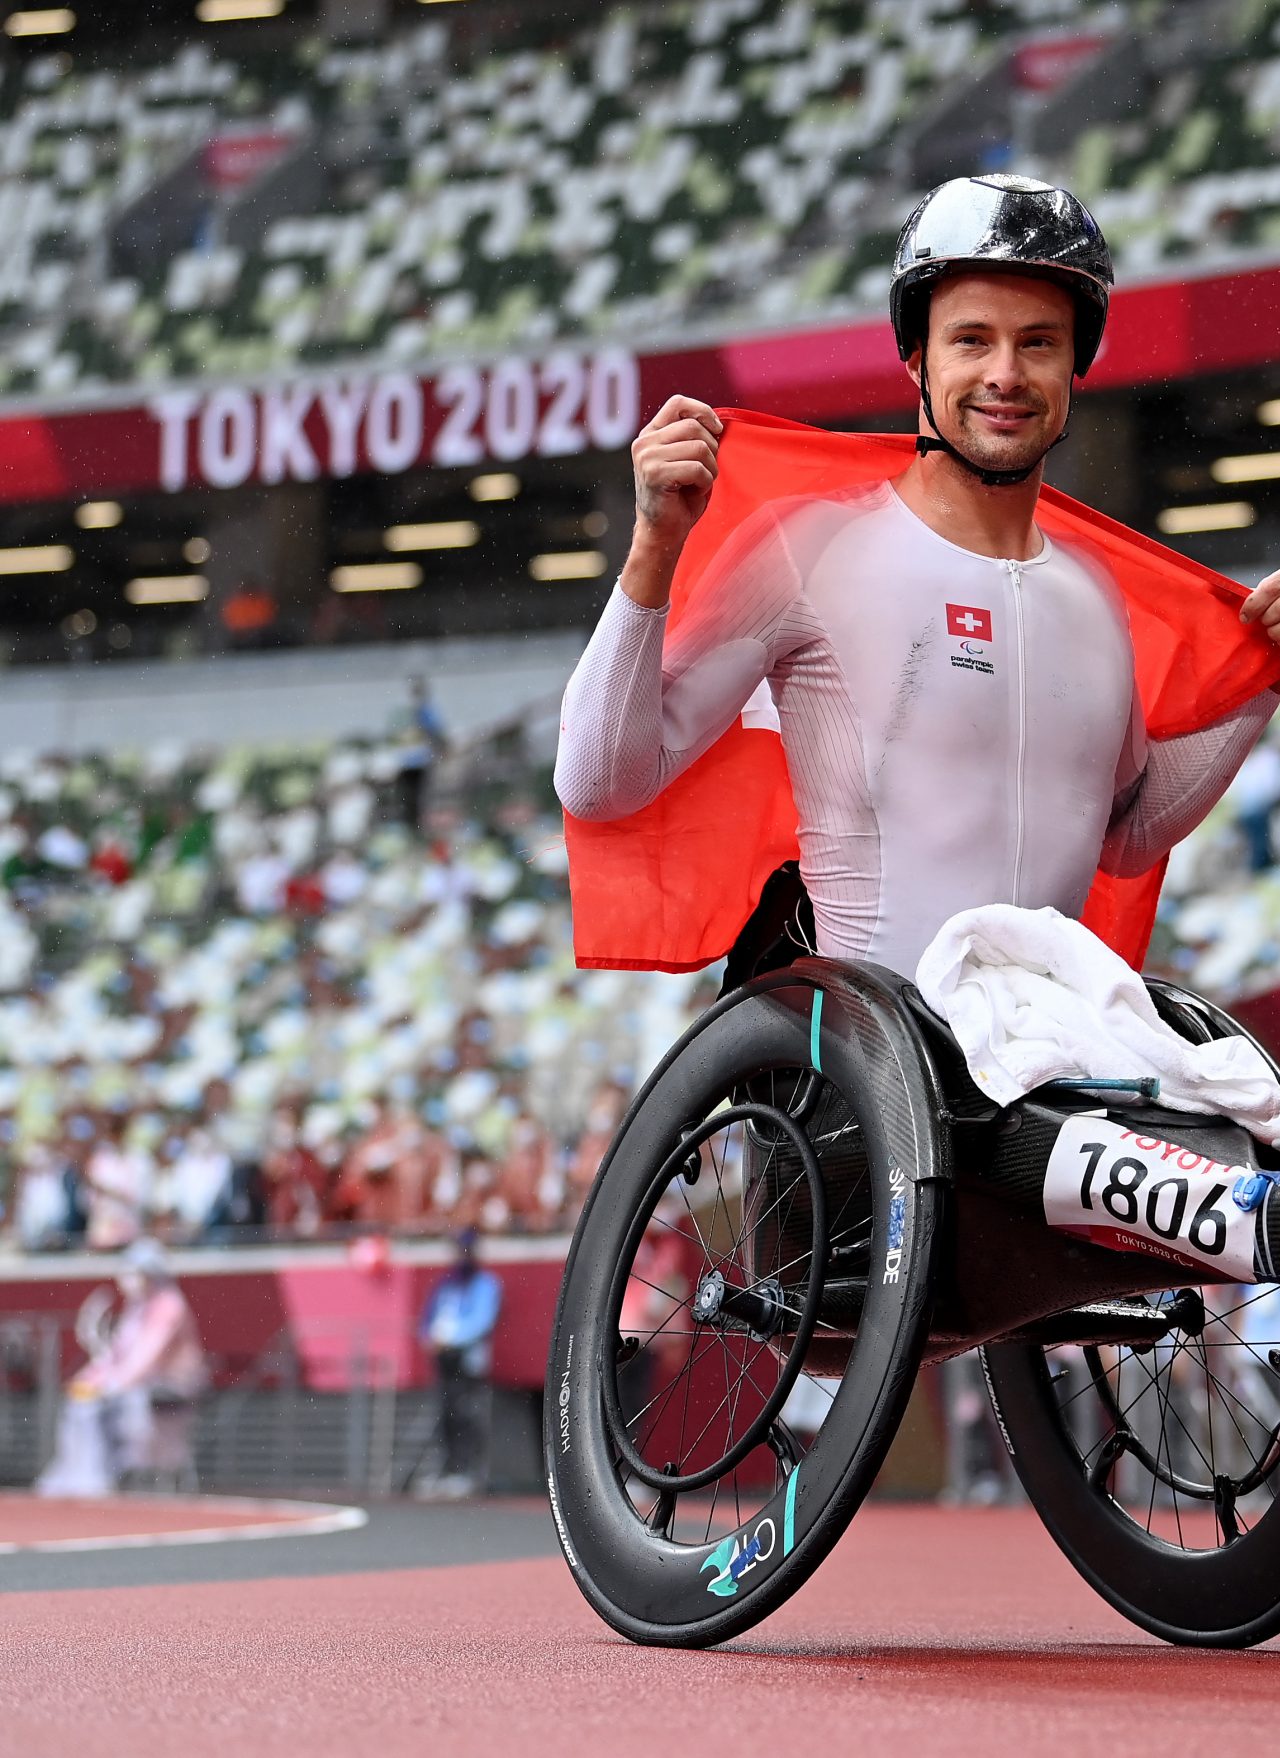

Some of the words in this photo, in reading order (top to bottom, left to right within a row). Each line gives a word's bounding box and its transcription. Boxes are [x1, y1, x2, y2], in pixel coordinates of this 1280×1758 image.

[151, 371, 424, 493] TOKYO
[432, 353, 640, 467] 2020
[950, 655, 994, 669] paralympic
[951, 661, 974, 670] swiss
[975, 665, 995, 675] team
[1079, 1142, 1228, 1256] 1806
[1115, 1232, 1148, 1250] TOKYO
[1148, 1243, 1172, 1259] 2020
[559, 1371, 572, 1454] HADRON
[547, 1471, 578, 1567] CONTINENTAL
